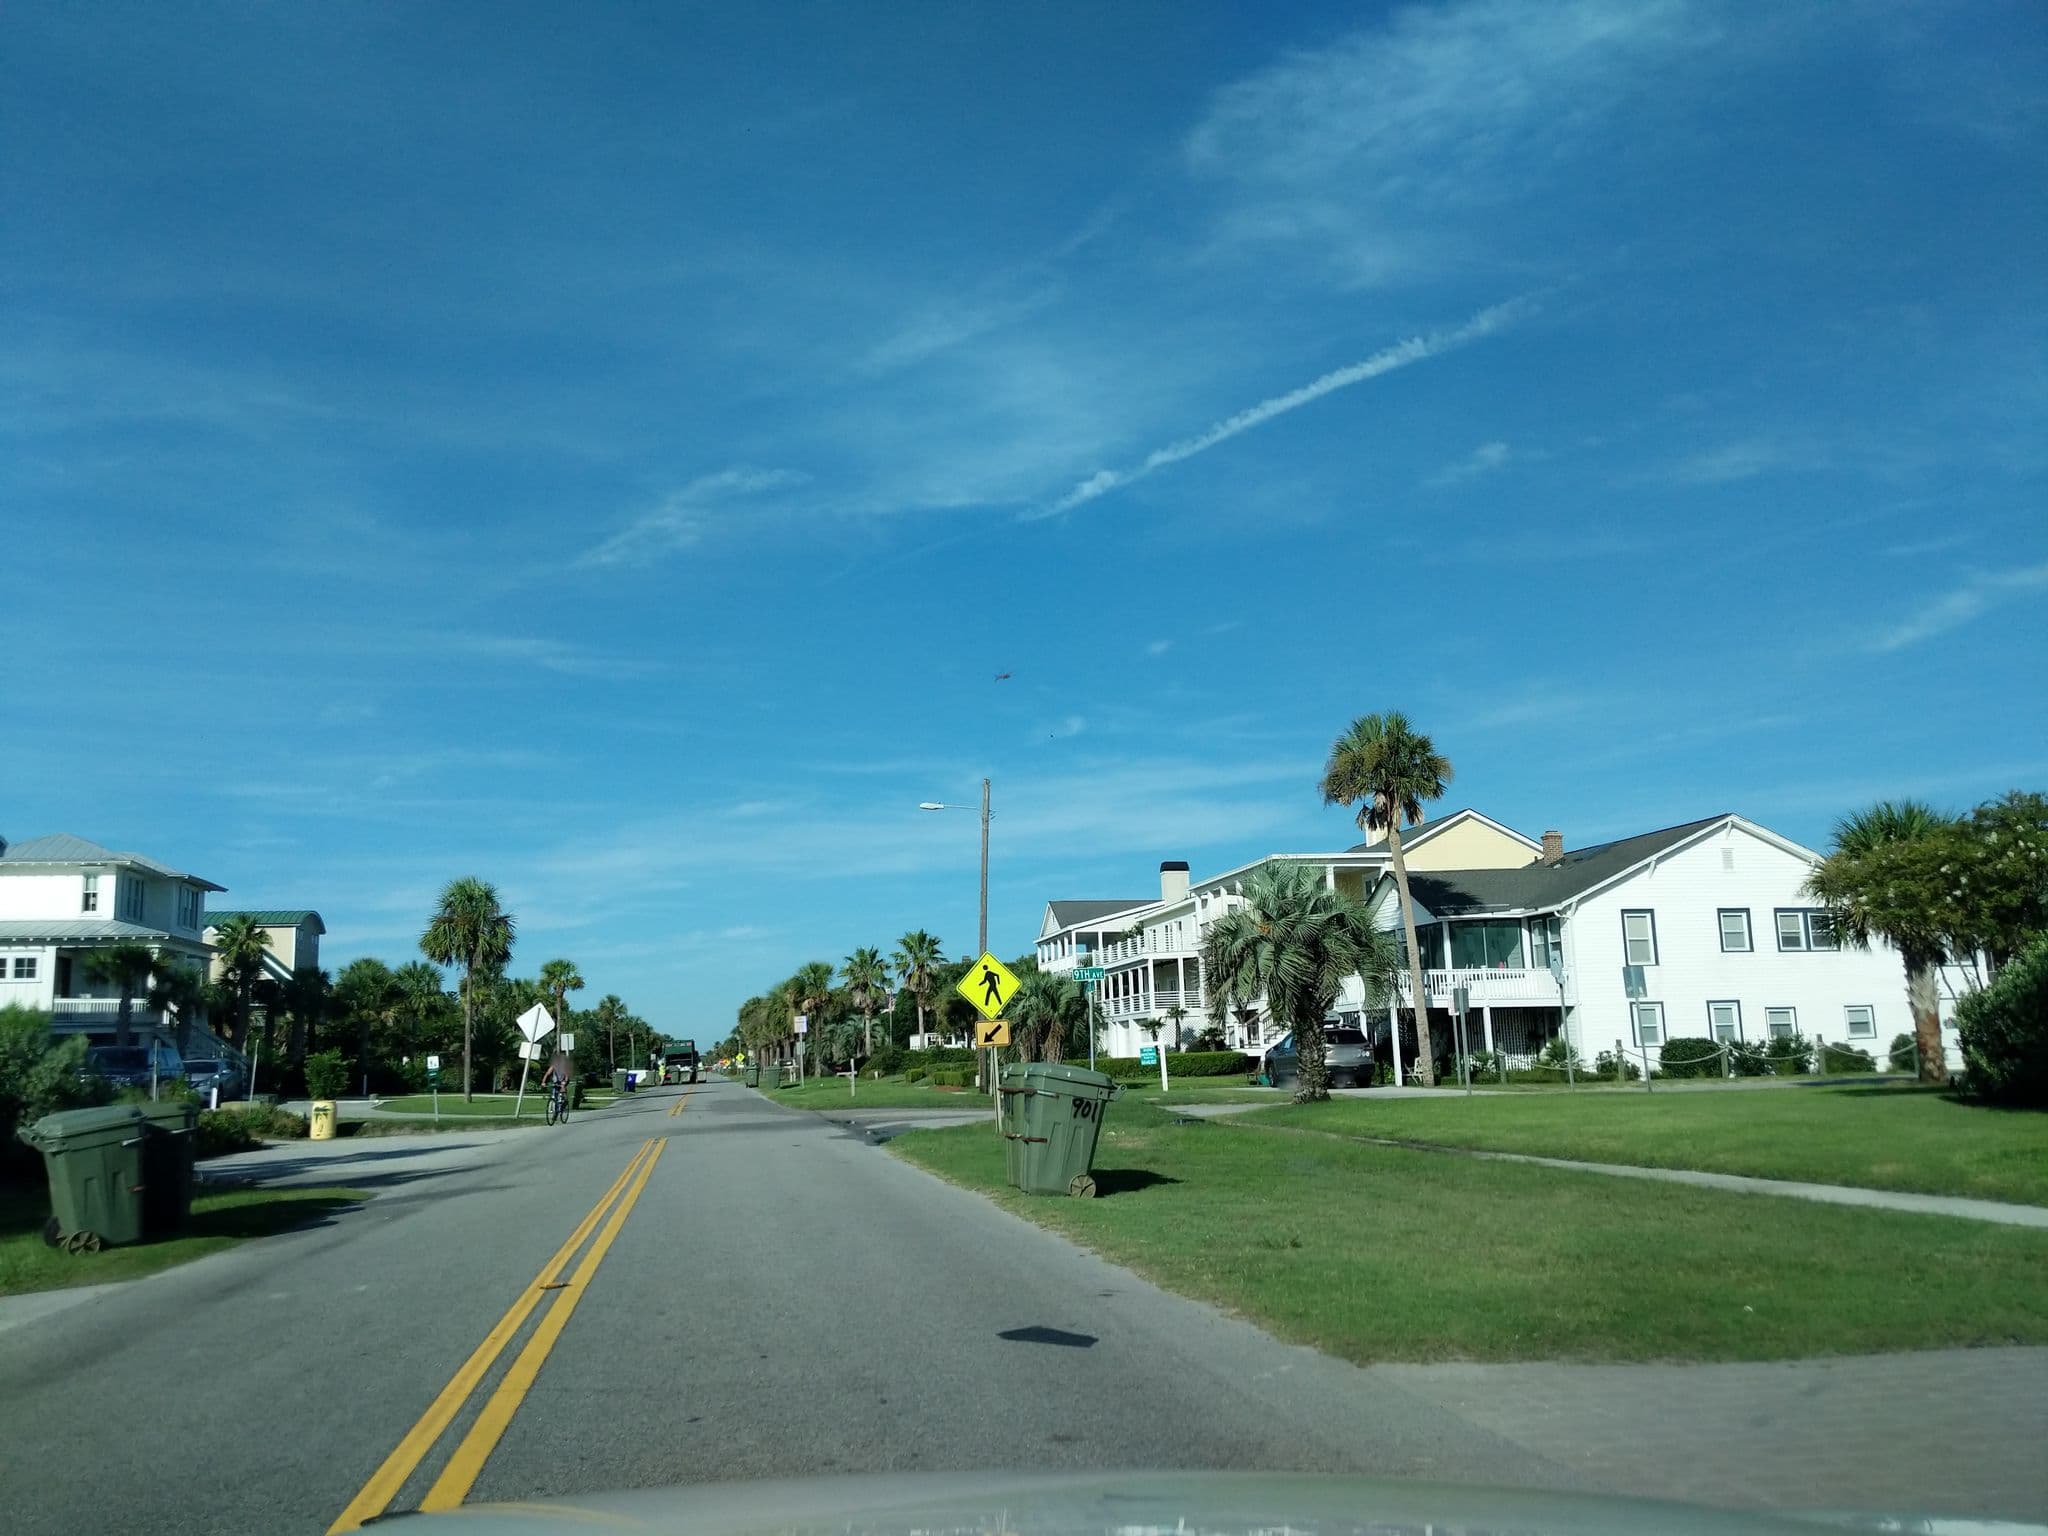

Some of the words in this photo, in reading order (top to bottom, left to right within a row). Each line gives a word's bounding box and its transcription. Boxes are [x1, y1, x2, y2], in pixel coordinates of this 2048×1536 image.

[1073, 969, 1090, 980] 9TH
[1092, 971, 1104, 979] AVE
[1072, 1097, 1099, 1123] 901
